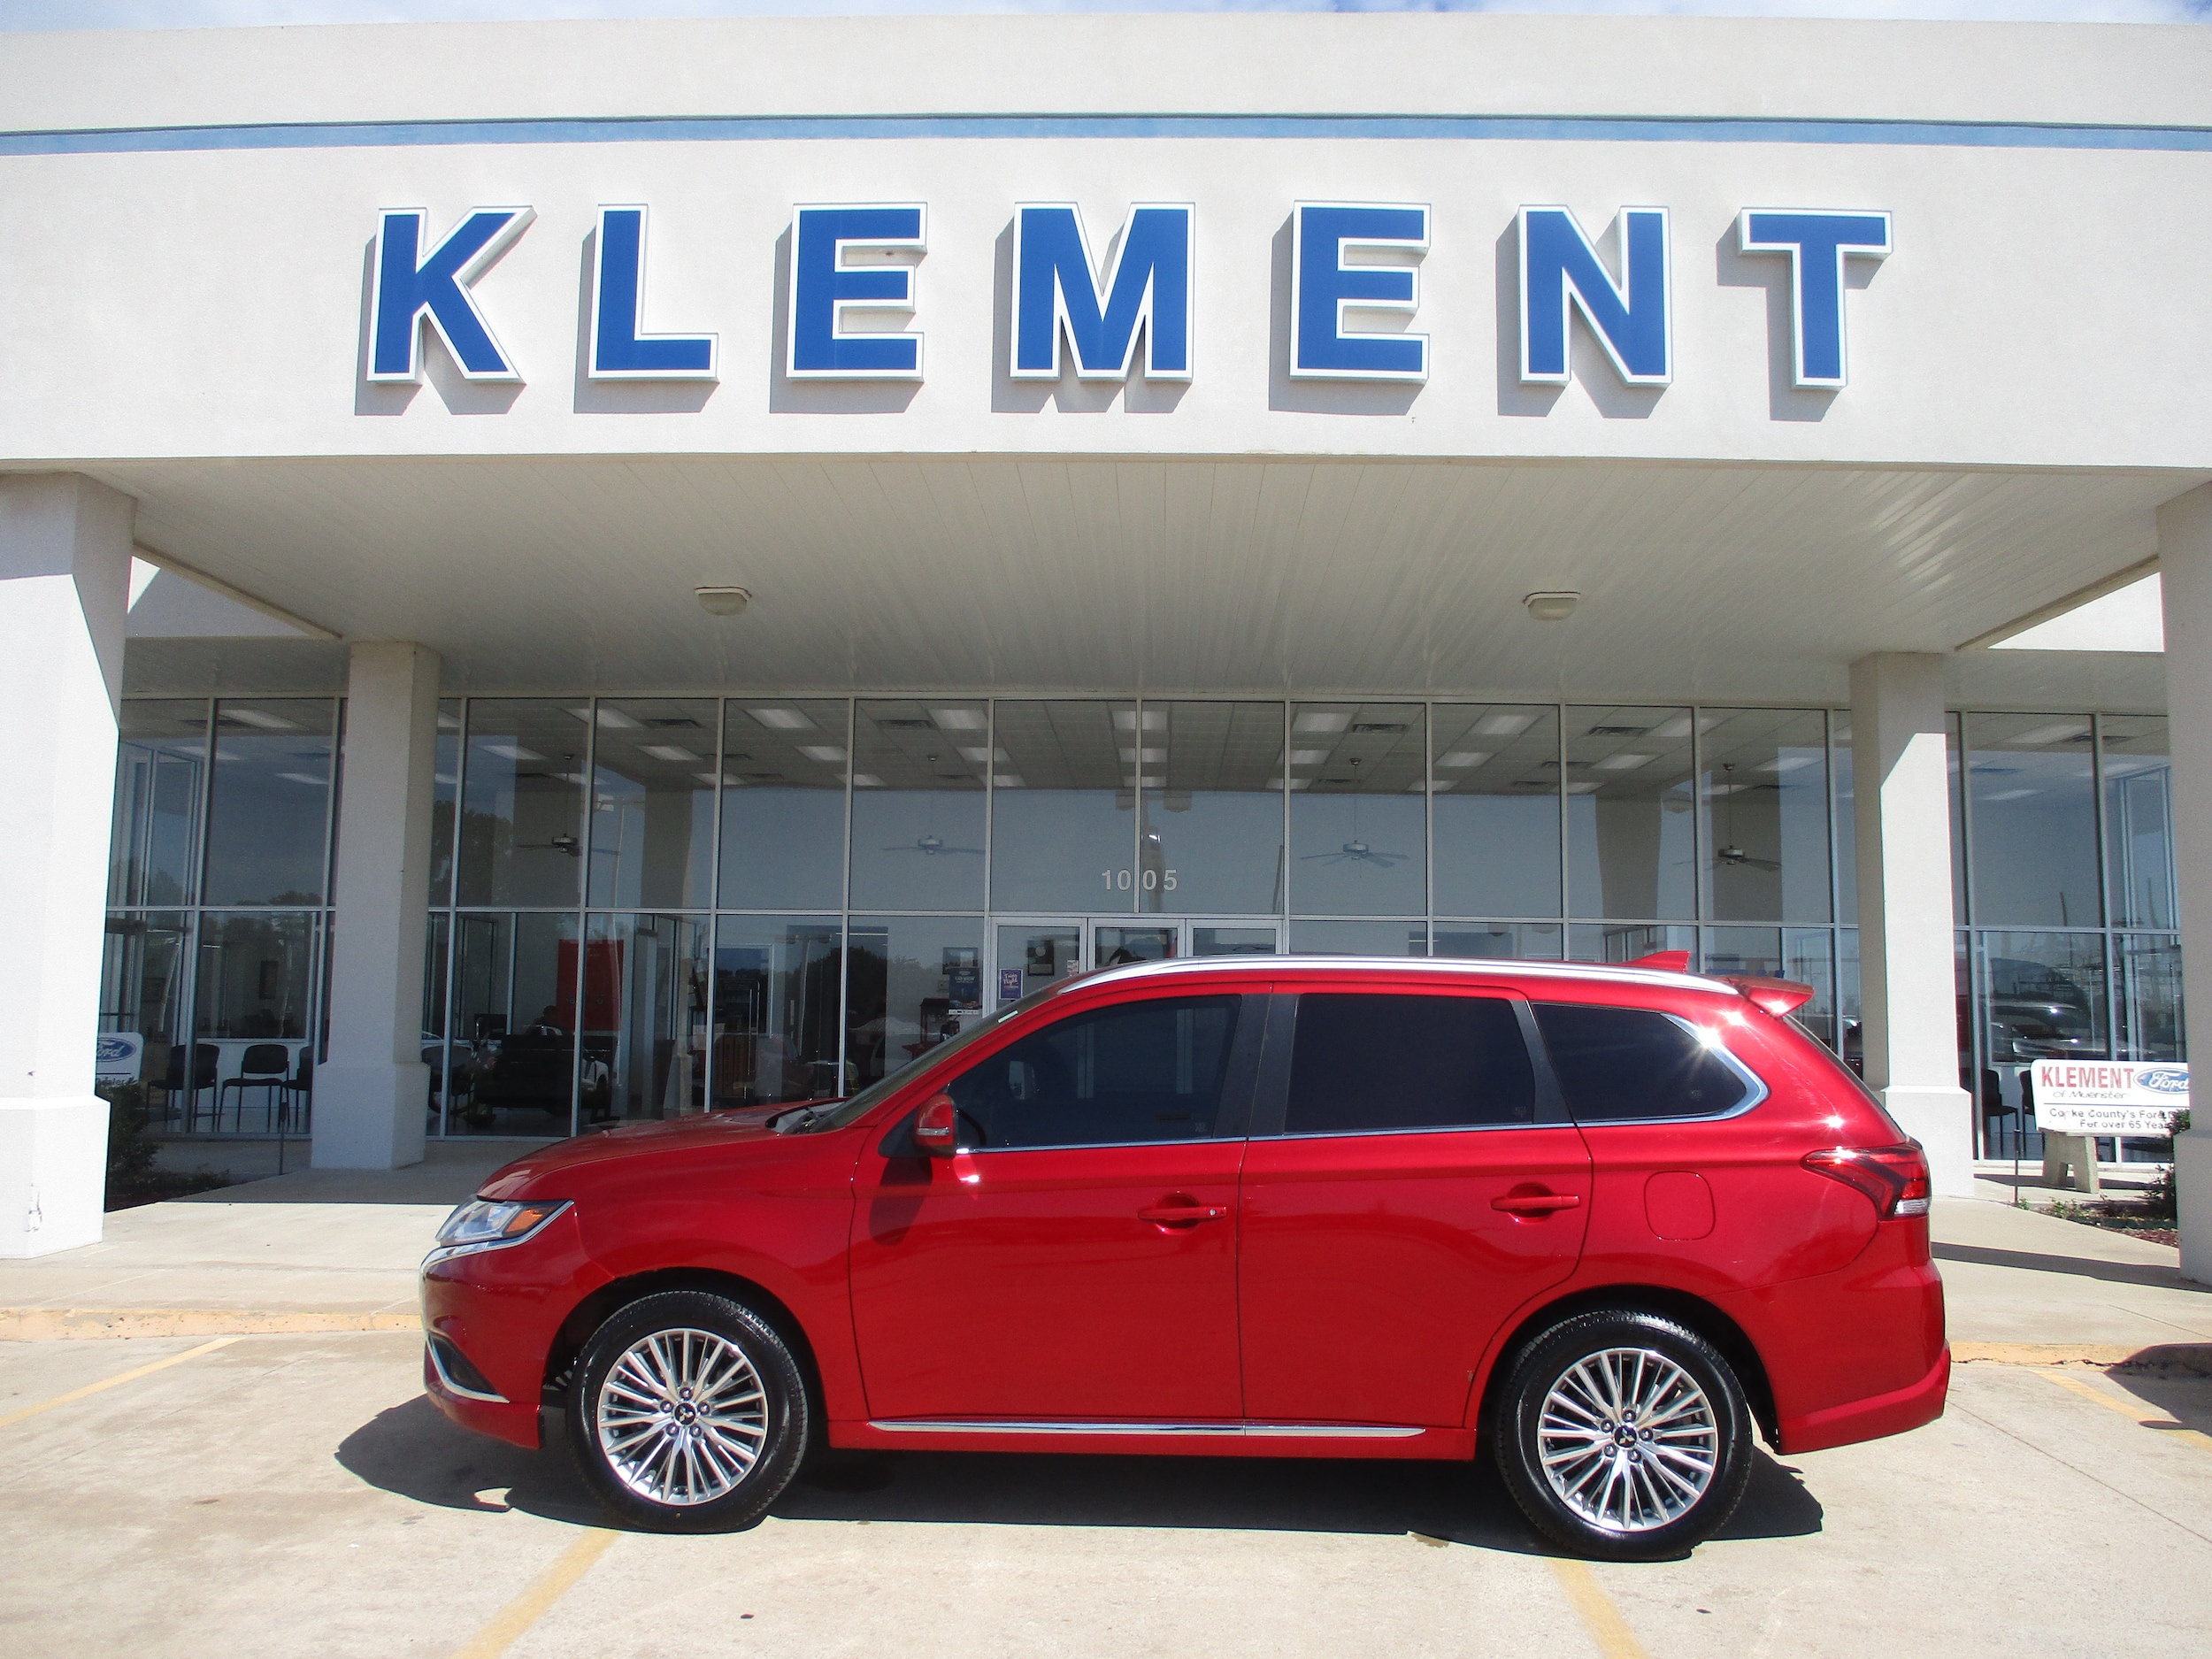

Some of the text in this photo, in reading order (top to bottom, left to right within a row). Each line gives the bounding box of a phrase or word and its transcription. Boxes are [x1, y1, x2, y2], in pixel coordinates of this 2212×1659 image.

[367, 201, 1893, 389] KLEMENT
[1102, 869, 1178, 891] 1005
[2041, 1066, 2134, 1088] KLEMENT
[2149, 1071, 2189, 1092] Ford
[2080, 1119, 2098, 1128] For
[2088, 1110, 2136, 1120] County's
